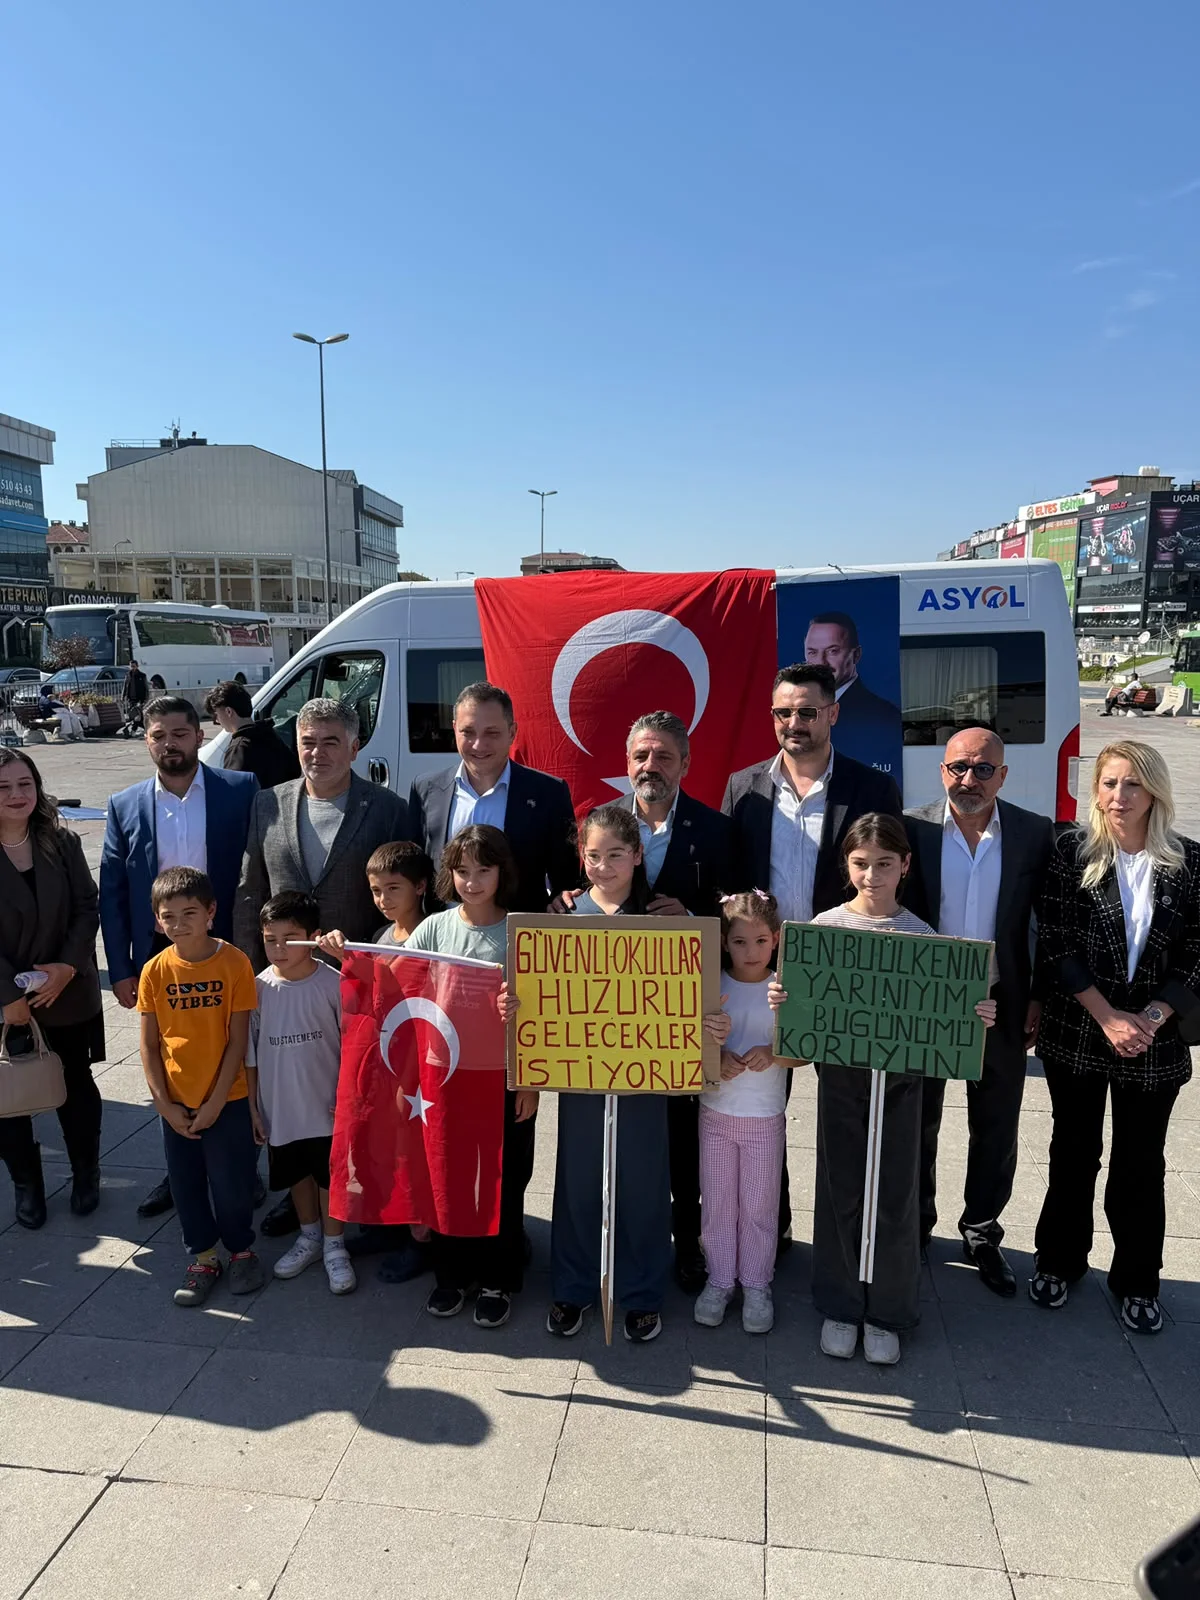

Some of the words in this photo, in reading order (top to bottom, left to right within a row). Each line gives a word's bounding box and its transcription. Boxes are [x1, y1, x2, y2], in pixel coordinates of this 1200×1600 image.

[1035, 503, 1058, 516] ELTES
[1173, 494, 1200, 504] UÇAR
[918, 585, 1025, 611] ASYOL
[167, 995, 223, 1010] VIBES
[538, 978, 698, 1018] HUZURLU
[517, 1019, 702, 1050] GELECEKLER
[813, 1004, 975, 1047] BUGÜNÜMÜ
[775, 1026, 962, 1080] KORUYUN
[517, 1053, 702, 1090] İSTİYORUZ
